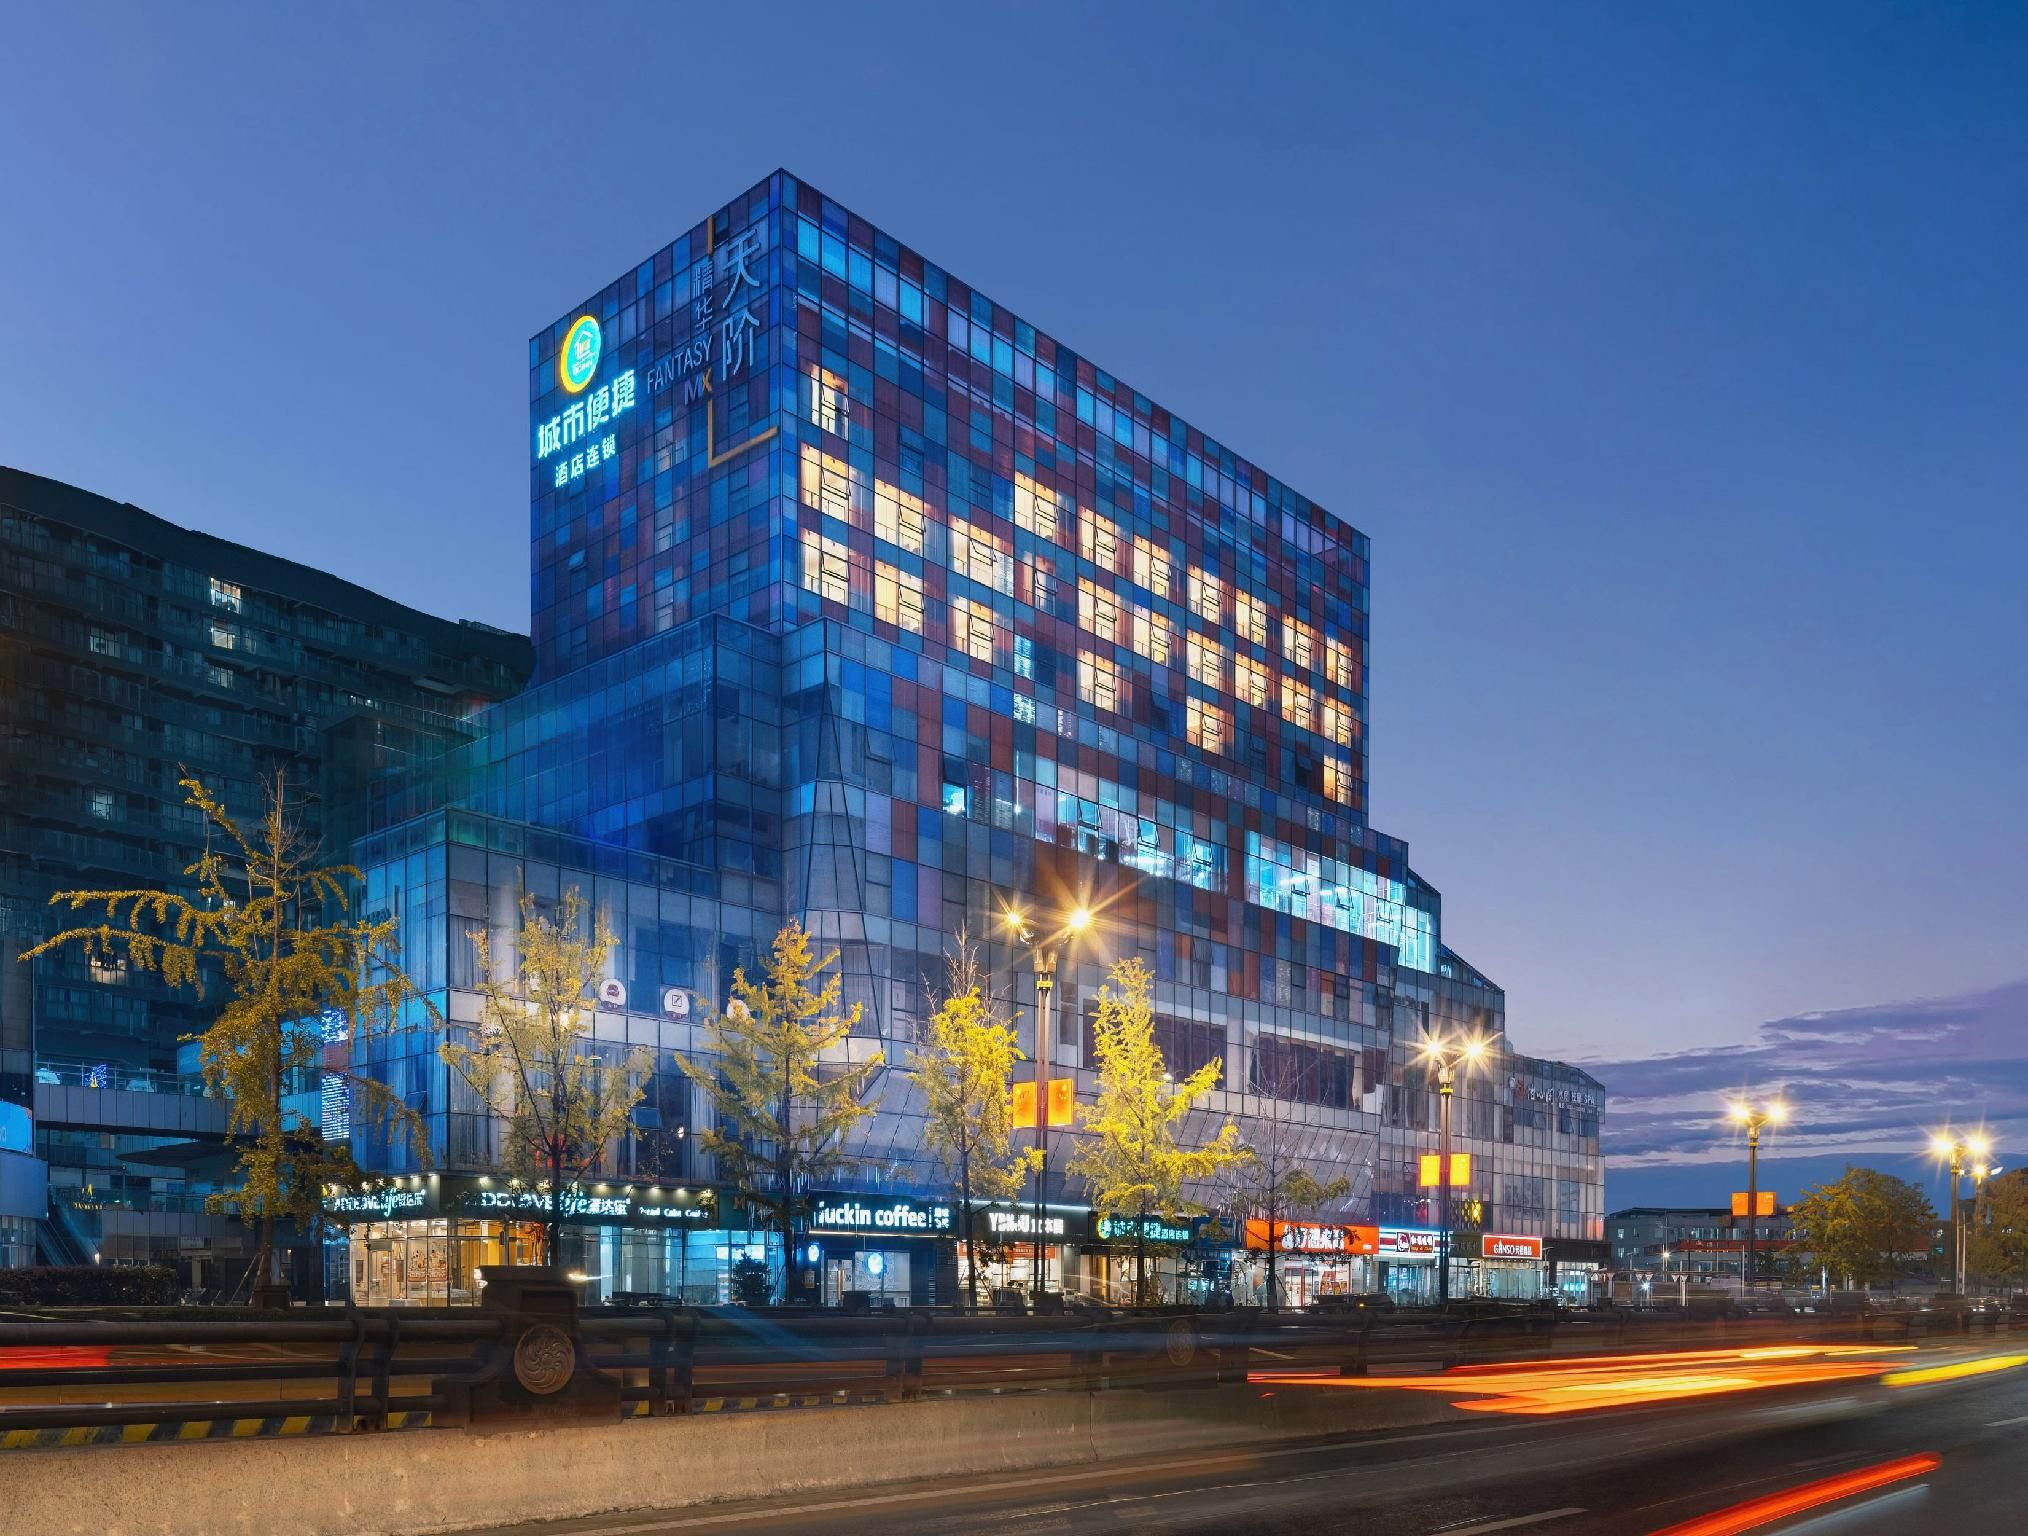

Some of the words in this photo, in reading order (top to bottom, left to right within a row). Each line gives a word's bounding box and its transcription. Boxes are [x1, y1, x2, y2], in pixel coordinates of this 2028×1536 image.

[722, 228, 761, 381] 天阶
[647, 334, 713, 394] FANTASY
[537, 369, 635, 459] 城市便捷
[555, 433, 616, 488] 酒店连锁
[875, 1205, 927, 1227] coffee
[1494, 1240, 1515, 1255] GANSO
